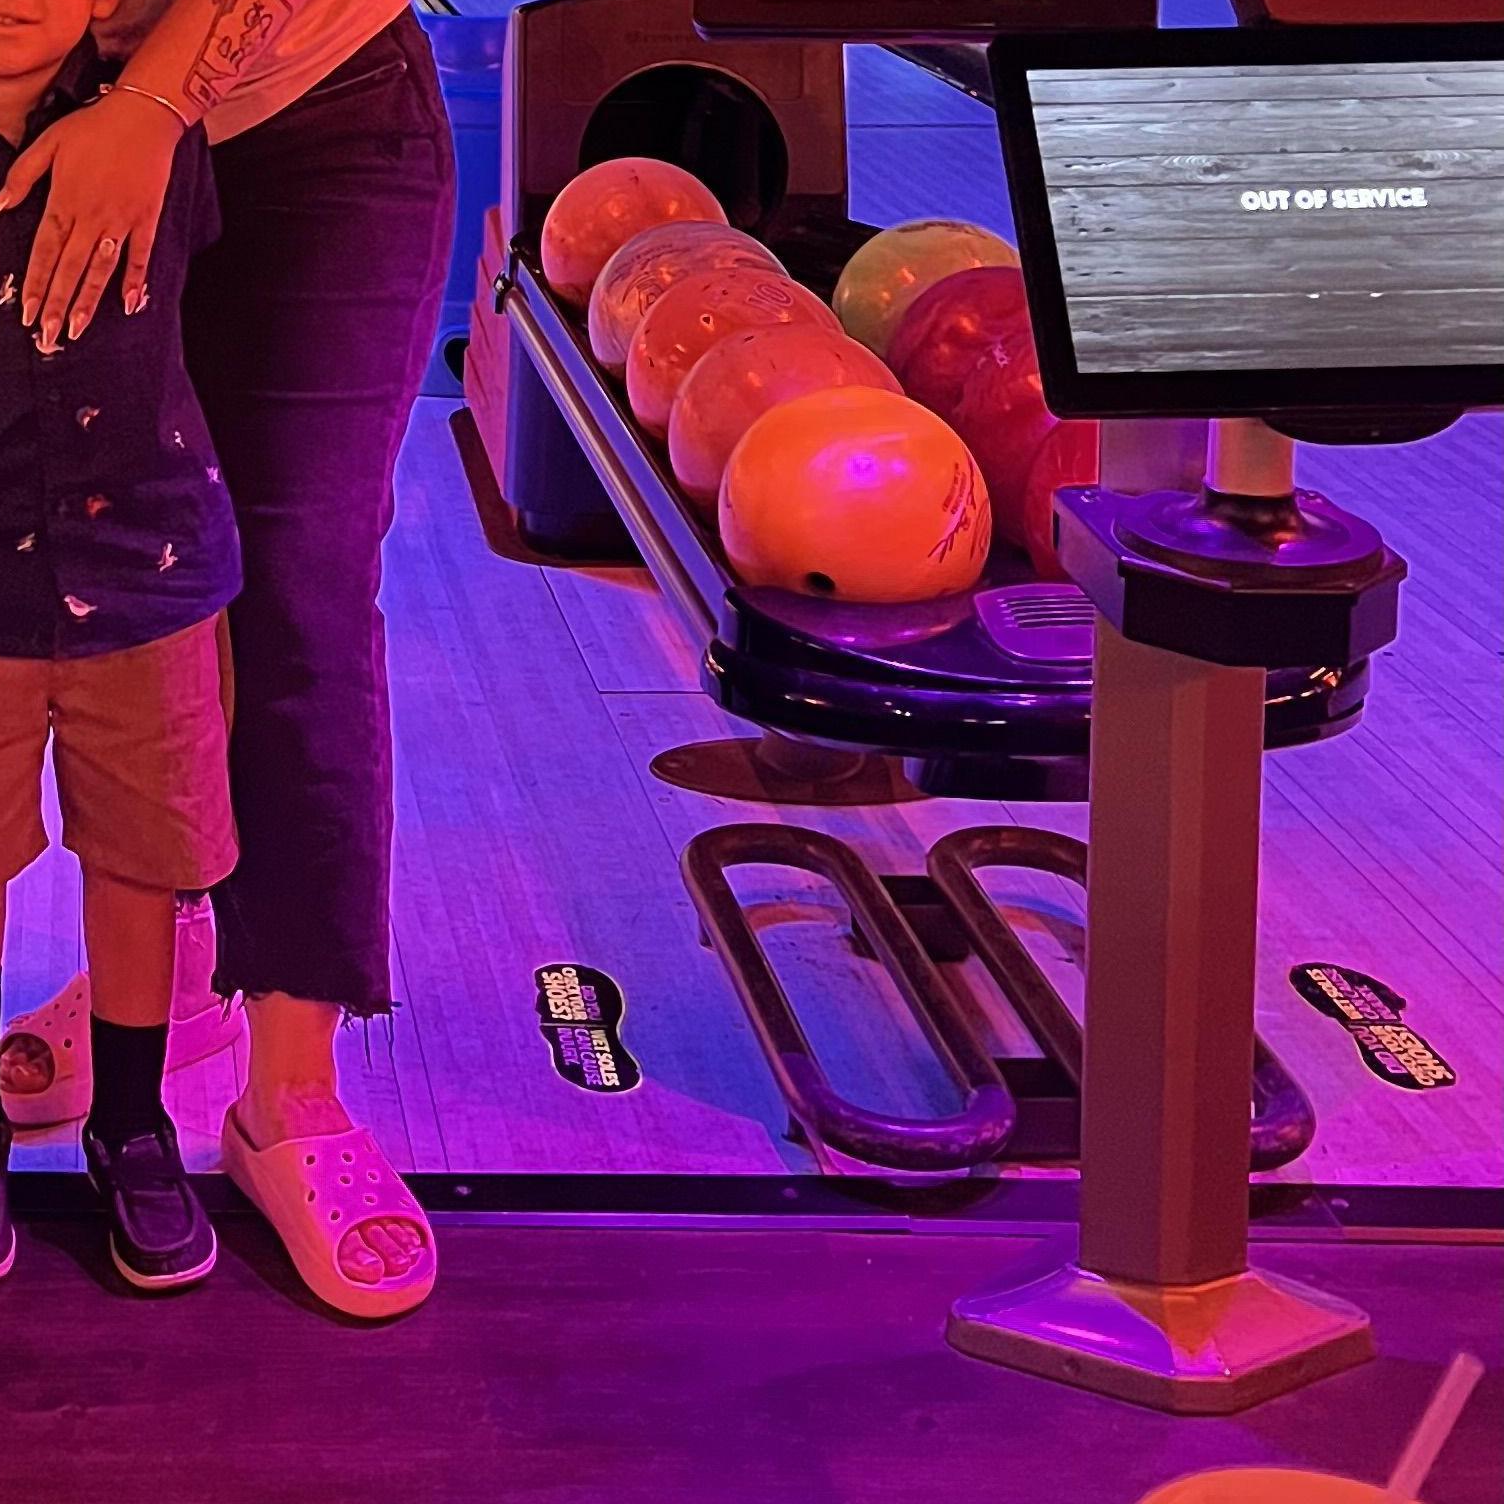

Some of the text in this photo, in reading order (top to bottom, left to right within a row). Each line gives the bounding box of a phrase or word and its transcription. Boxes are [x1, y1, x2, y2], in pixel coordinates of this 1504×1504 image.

[1240, 187, 1428, 212] OUT OF SERVICE
[541, 971, 573, 1021] SHOES?
[575, 1028, 603, 1086] CAN CAUSE
[590, 1029, 620, 1086] WET SOLES
